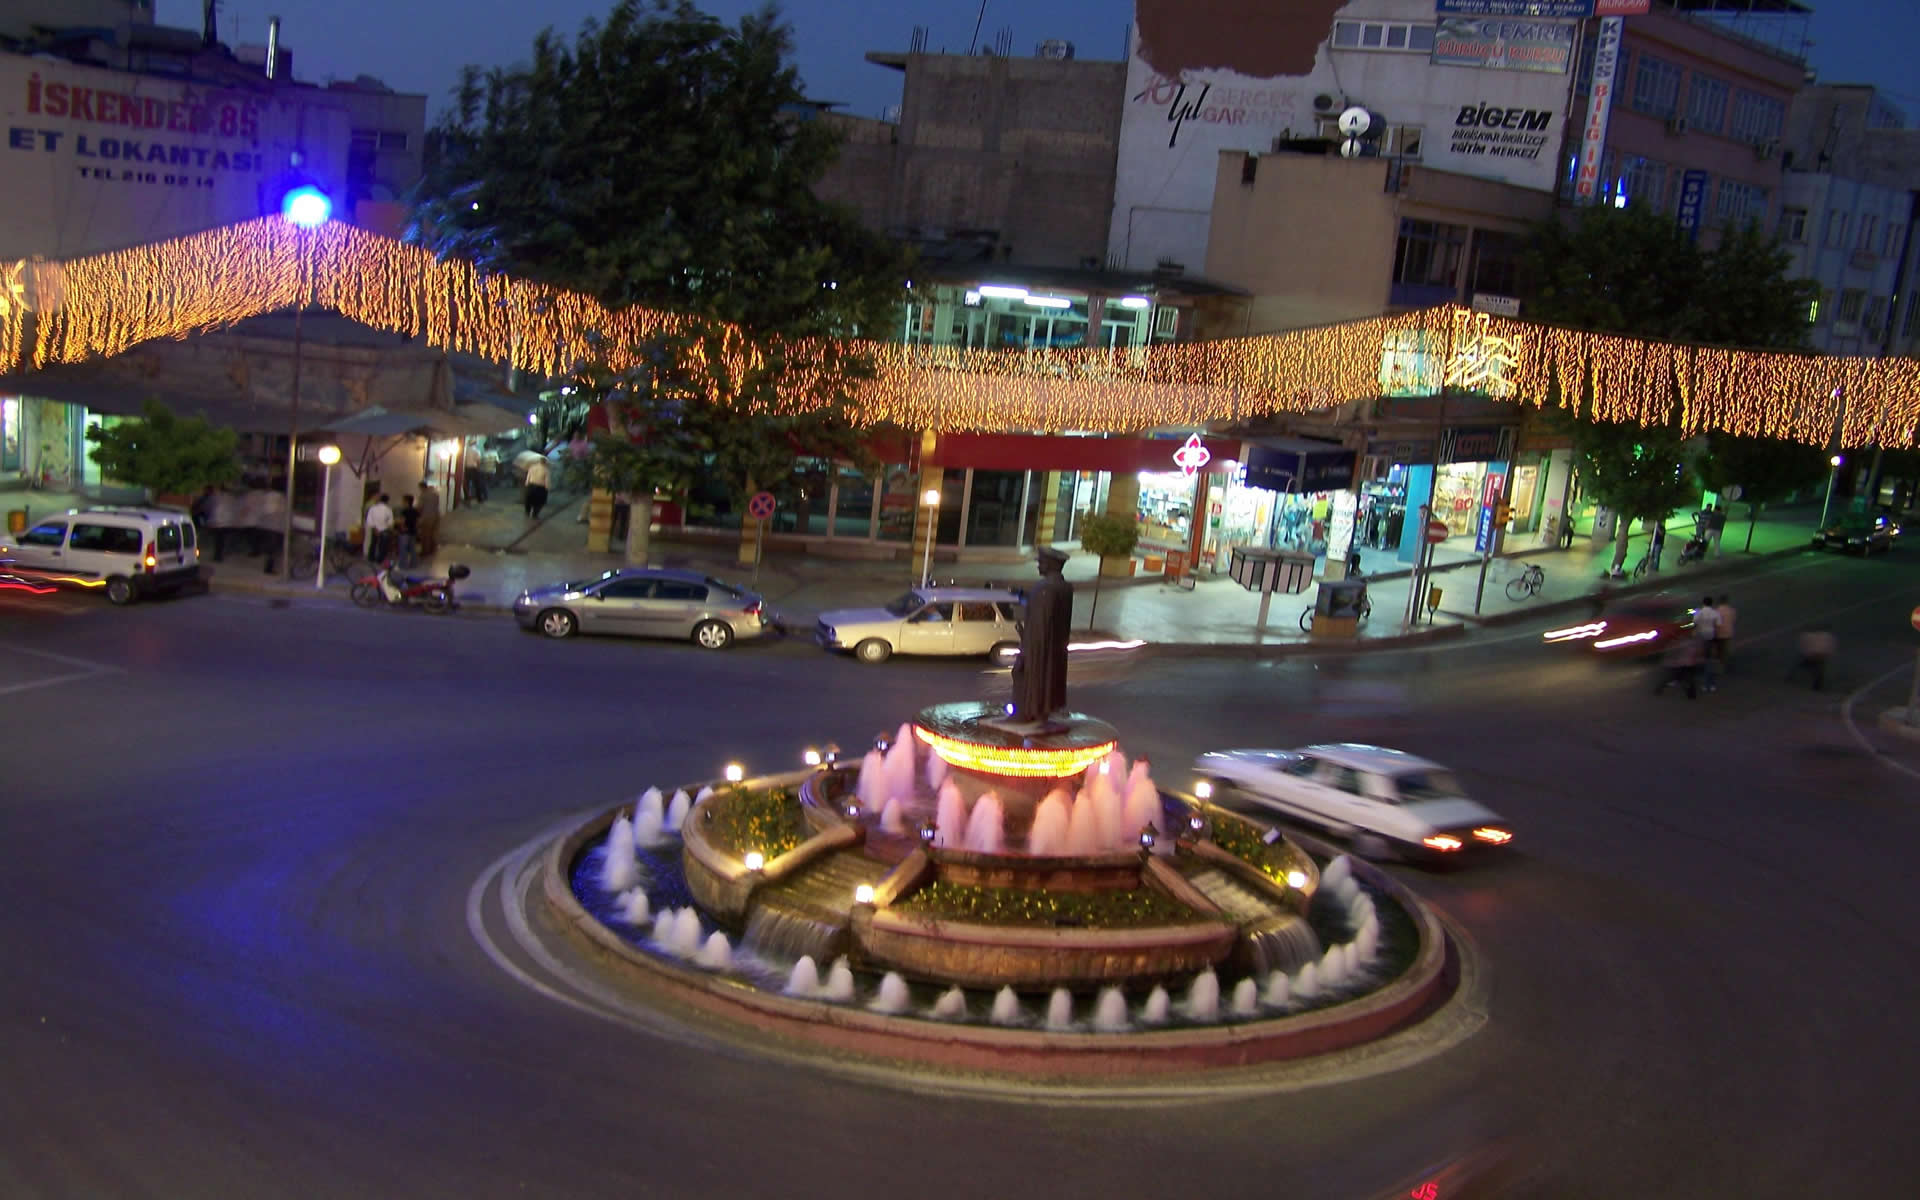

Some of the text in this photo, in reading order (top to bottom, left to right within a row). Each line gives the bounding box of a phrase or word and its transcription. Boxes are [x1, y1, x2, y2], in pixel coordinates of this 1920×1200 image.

[1455, 101, 1553, 131] BİGEM
[9, 127, 262, 173] ET LOKANTASI
